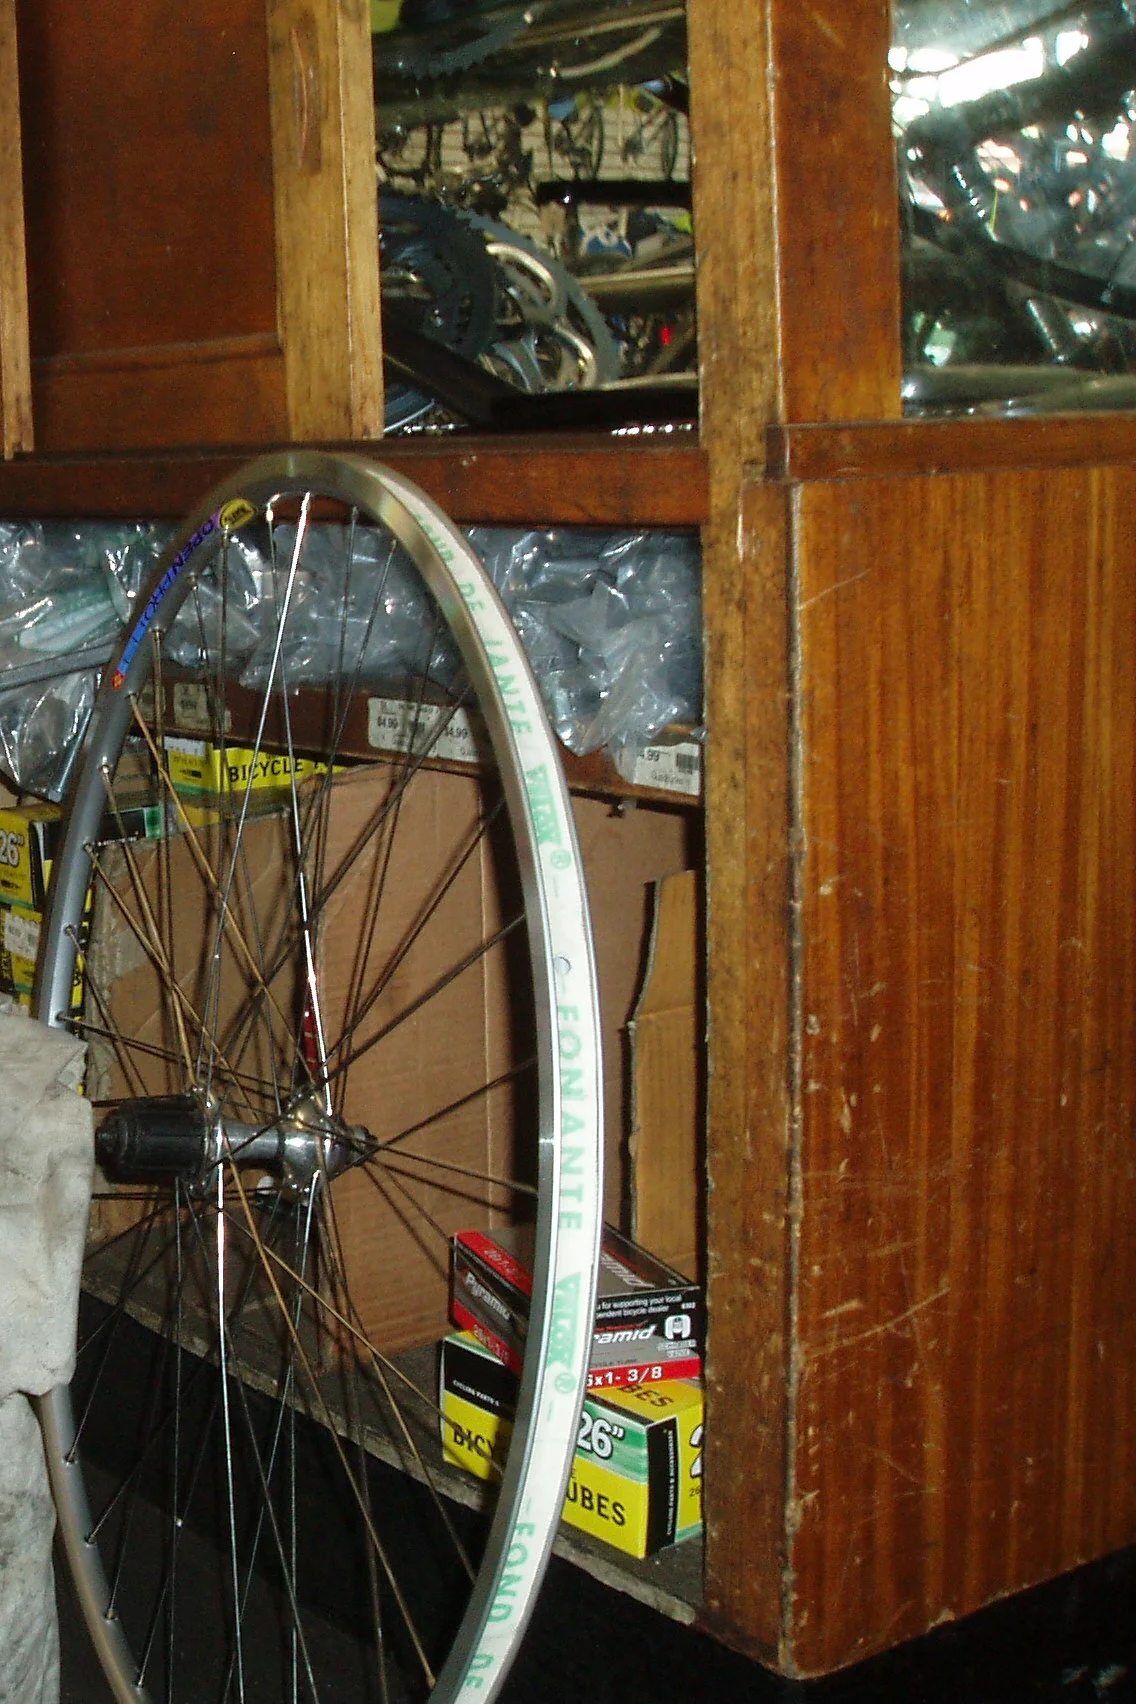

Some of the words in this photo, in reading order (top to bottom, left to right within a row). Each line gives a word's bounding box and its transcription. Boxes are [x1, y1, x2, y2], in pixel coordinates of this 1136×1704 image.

[228, 759, 303, 782] BICYCLE
[556, 1004, 586, 1231] FONANTE
[613, 1299, 648, 1310] supporting
[650, 1297, 665, 1306] your
[666, 1294, 682, 1303] local
[489, 1522, 536, 1623] FOND
